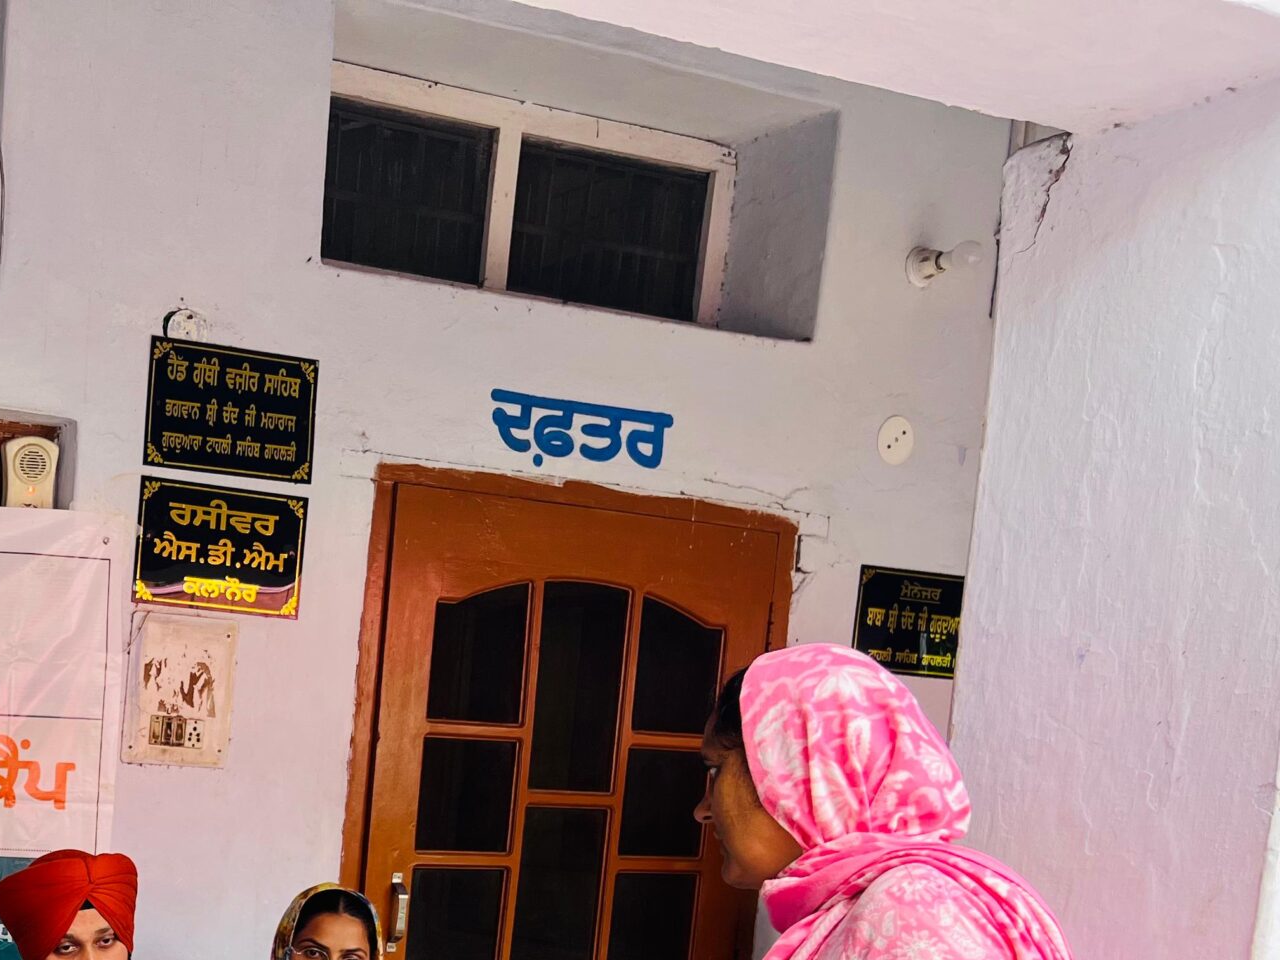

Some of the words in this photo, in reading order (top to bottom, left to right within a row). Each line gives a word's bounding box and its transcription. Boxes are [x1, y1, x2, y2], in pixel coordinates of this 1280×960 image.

[264, 368, 301, 398] ਸਾਹਿਬ
[165, 399, 201, 420] ਭਗਵਾਨ
[245, 404, 256, 427] ਜੀ
[261, 412, 296, 432] ਮਹਾਰਾਜ
[490, 388, 674, 469] ਦਫ਼ਤਰ
[236, 436, 261, 458] ਸਾਹਿਬ
[169, 499, 279, 536] ਰਸੀਵਰ
[153, 531, 288, 572] ਐਸ.ਡੀ.ਐਮ
[182, 576, 261, 603] ਕਲਾਨੌਰ
